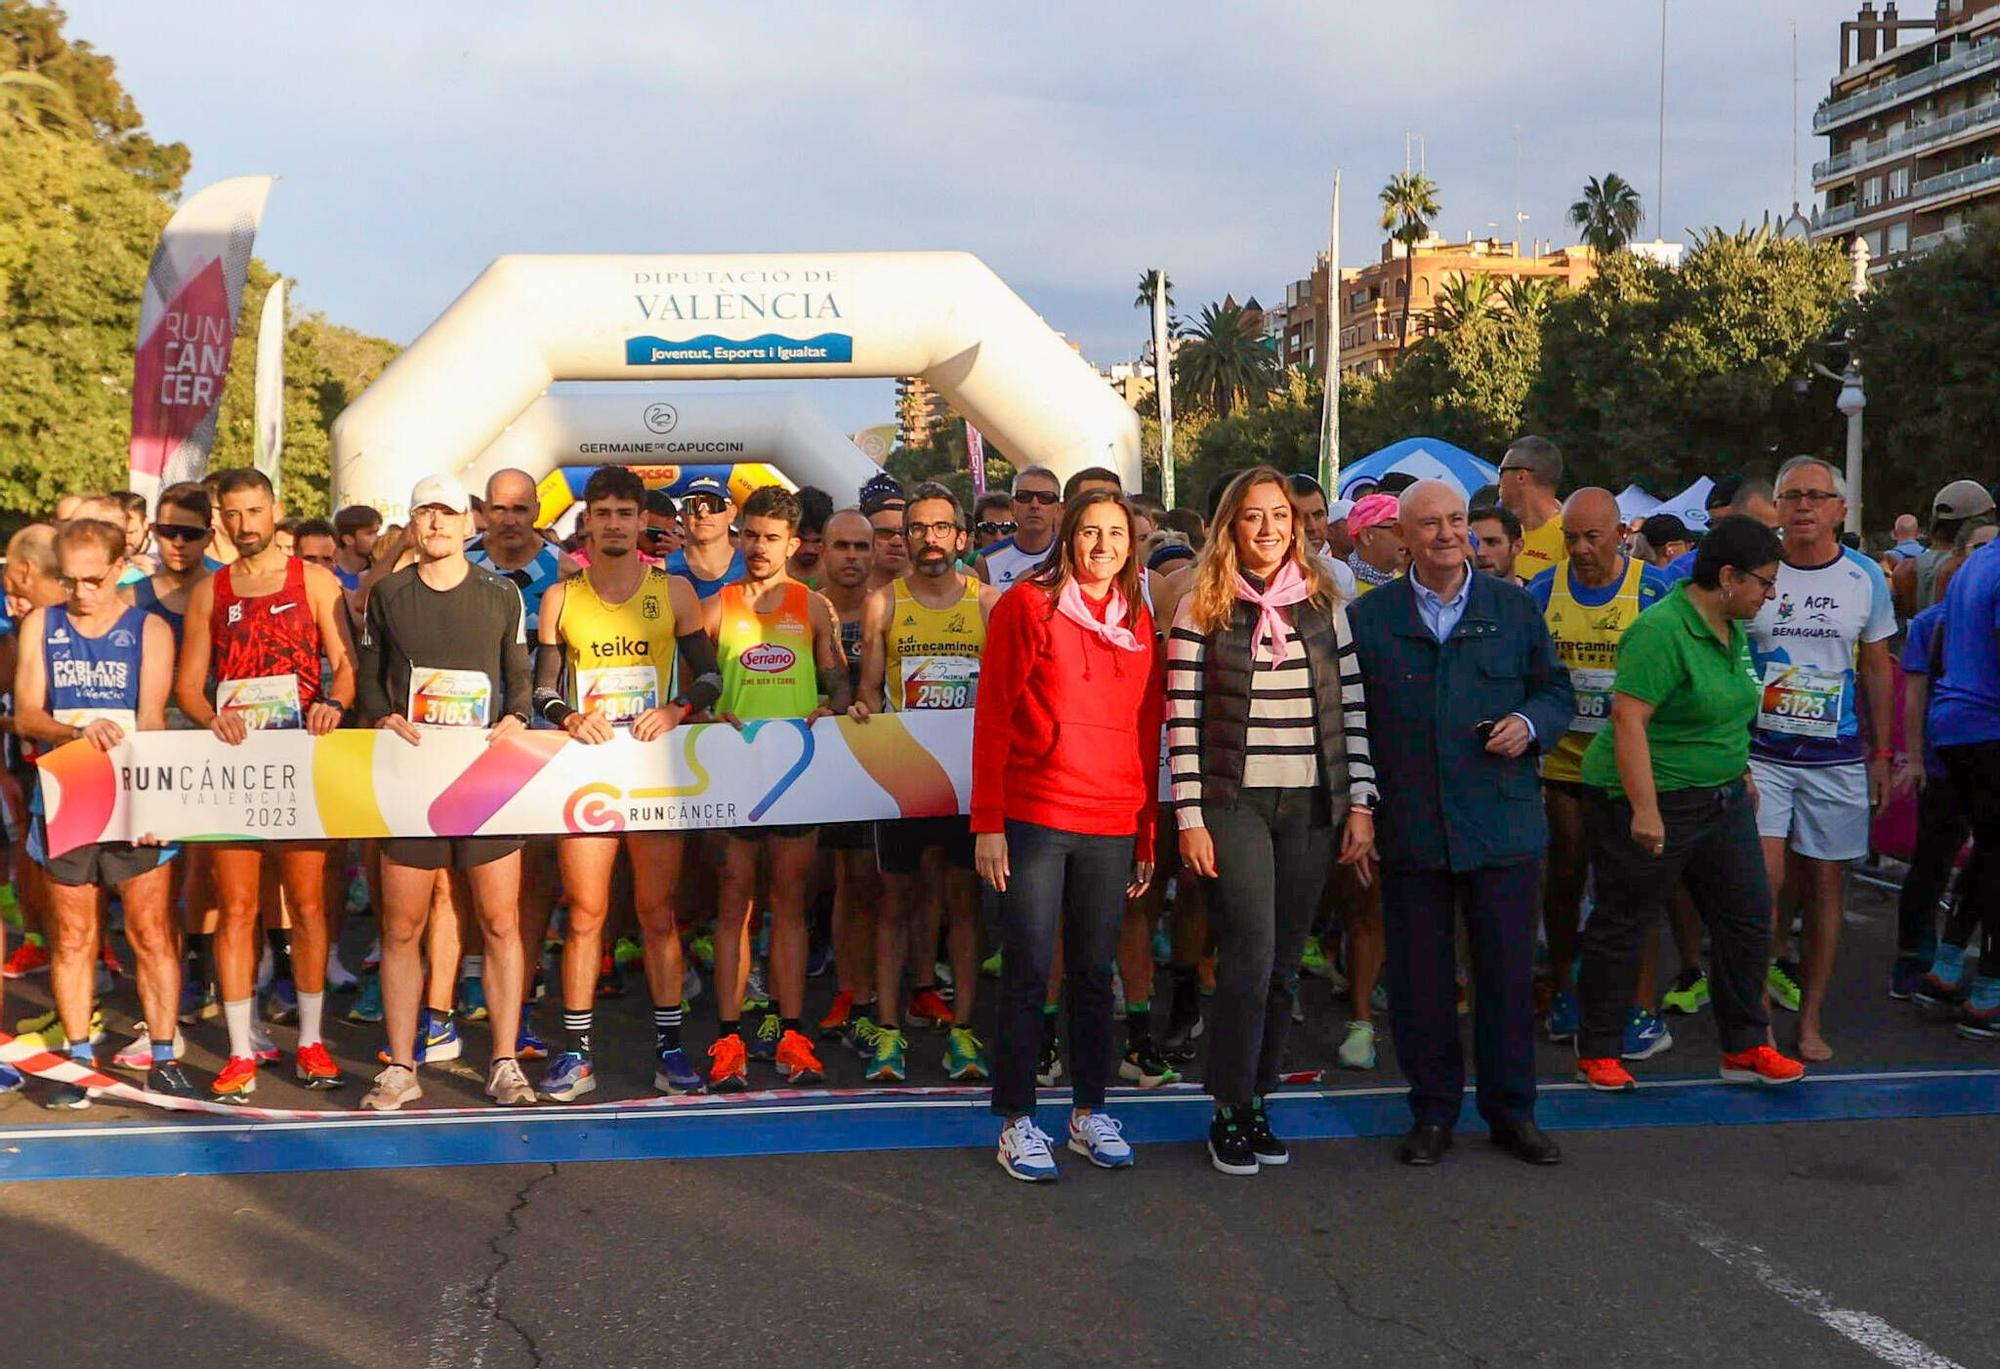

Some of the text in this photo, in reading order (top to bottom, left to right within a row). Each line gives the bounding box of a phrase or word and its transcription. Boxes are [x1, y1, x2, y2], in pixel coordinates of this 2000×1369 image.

[804, 270, 838, 283] DE
[634, 287, 843, 321] VALÈNCIA
[166, 312, 225, 345] RUN
[650, 345, 827, 362] Joventut, Esports i Igualtat
[160, 374, 213, 406] CER
[579, 443, 653, 454] GERMAINE
[666, 442, 743, 453] CAPUCCINI
[1804, 596, 1839, 609] ACPL
[898, 635, 917, 644] s.d.
[1771, 626, 1841, 639] BENAGUASIL
[591, 636, 649, 657] teika
[897, 641, 979, 653] correcaminos
[53, 660, 128, 675] POBLATS
[745, 653, 792, 665] Serrano
[916, 686, 966, 708] 2598
[424, 700, 473, 725] 3163
[1776, 693, 1826, 719] 3123
[122, 760, 296, 791] RUNCÁNCER
[181, 792, 297, 805] VALENCIA
[246, 808, 297, 827] 2023
[629, 802, 736, 820] RUNCÁNCER
